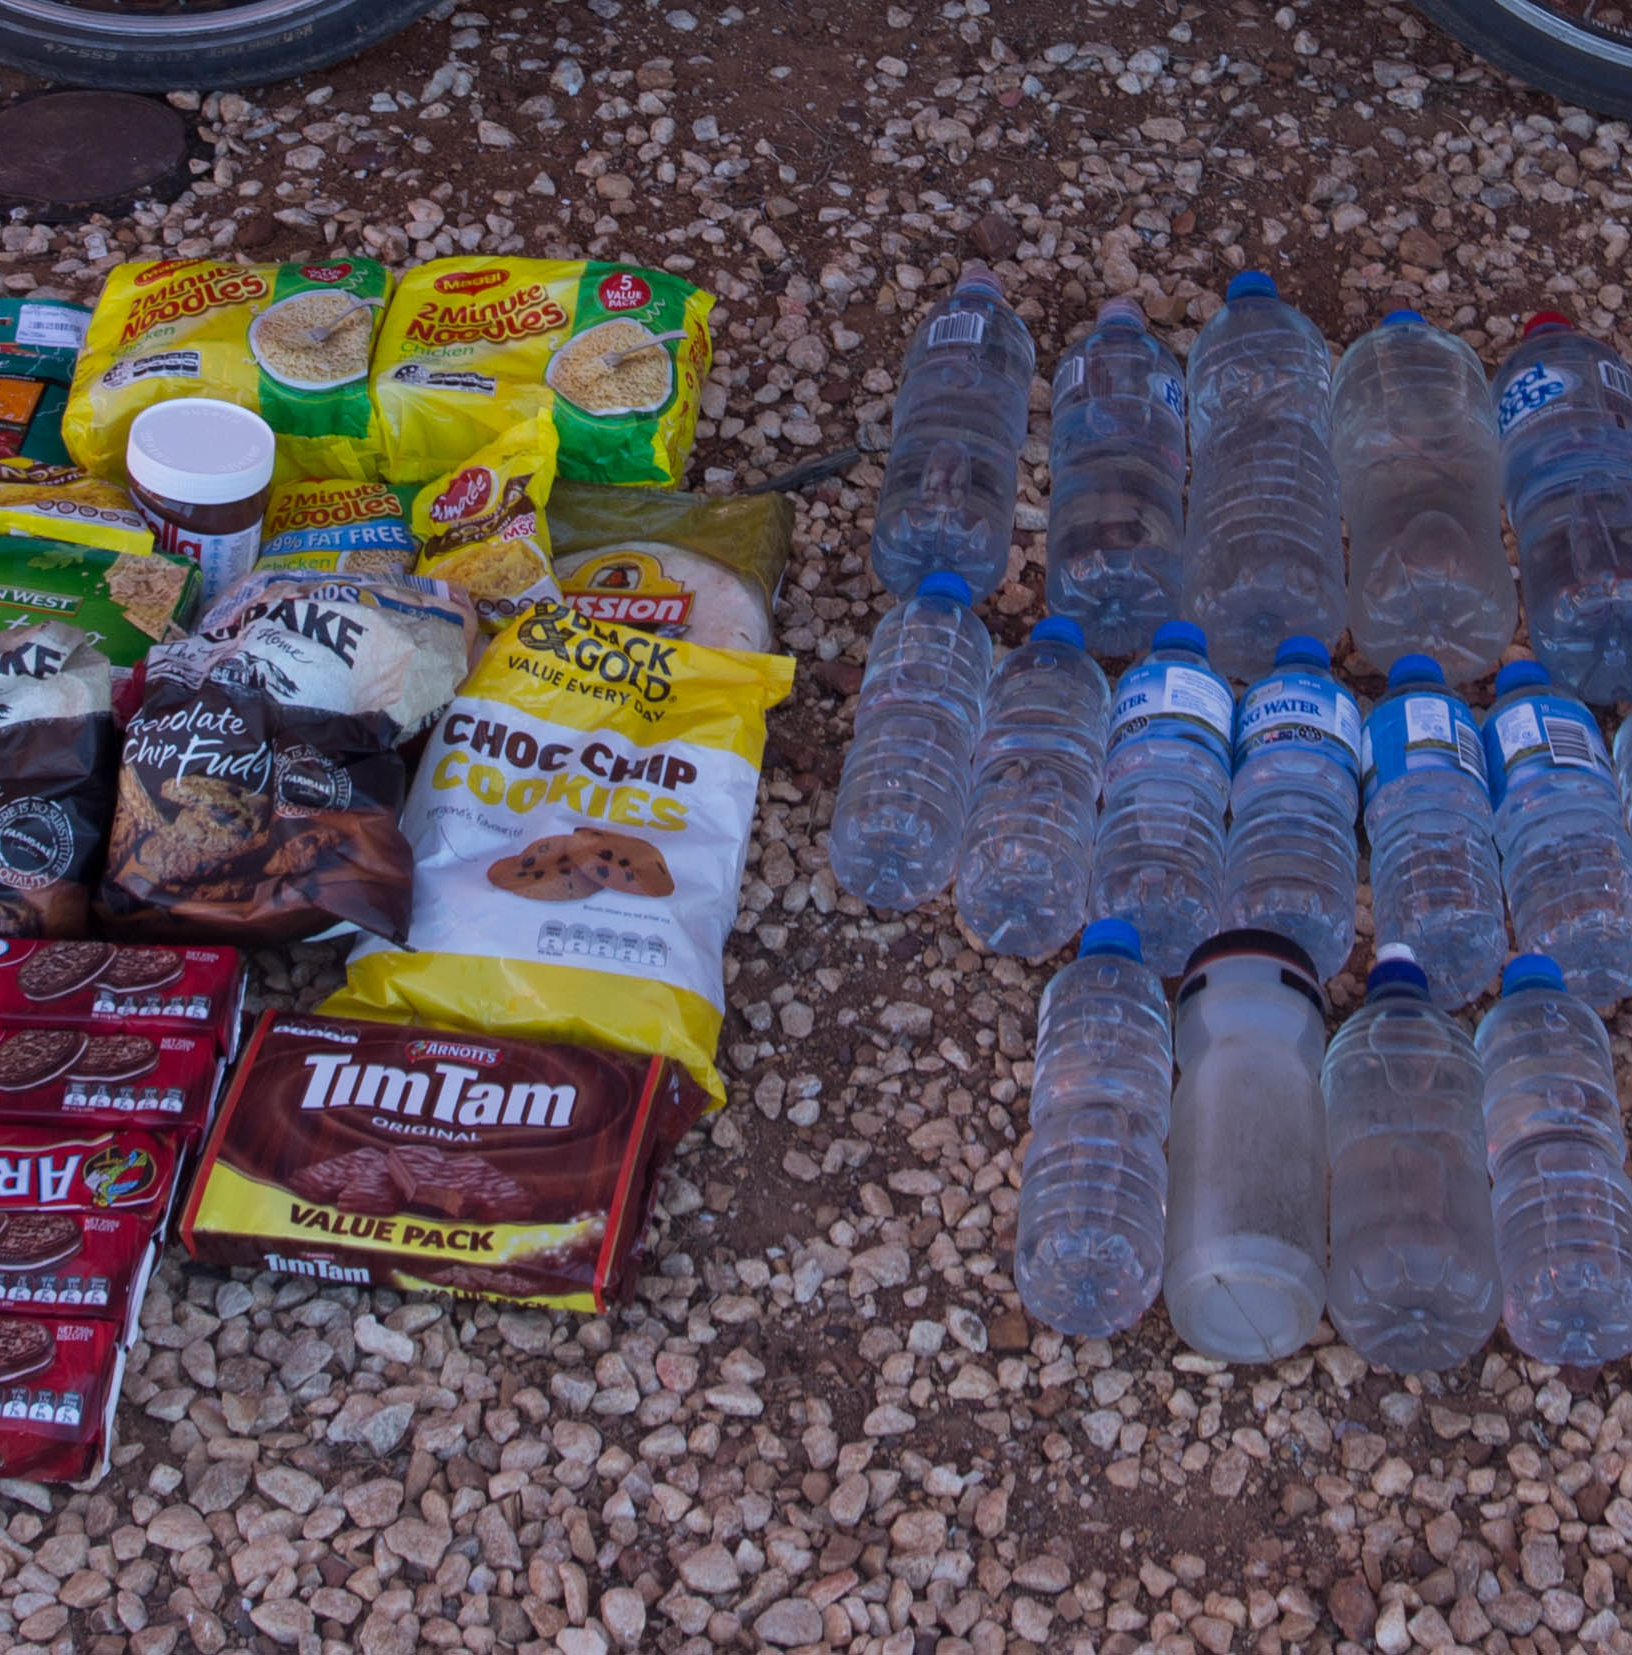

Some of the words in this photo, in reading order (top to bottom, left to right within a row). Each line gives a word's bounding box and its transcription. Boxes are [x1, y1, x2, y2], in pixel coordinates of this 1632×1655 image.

[619, 274, 633, 292] 5
[417, 302, 439, 321] 2
[438, 283, 546, 324] Minute
[606, 290, 643, 301] VALUE
[608, 298, 637, 308] PACK
[127, 298, 141, 319] 2
[277, 495, 292, 513] 2
[307, 528, 344, 547] FAT
[348, 525, 409, 545] FREE
[11, 589, 74, 611] WEST
[517, 600, 577, 663] &
[574, 638, 672, 703] GOLD
[571, 612, 677, 677] BLACK
[508, 655, 564, 687] VALUE
[566, 677, 632, 706] EVERY
[633, 699, 666, 724] DAY
[1263, 698, 1322, 718] WATER
[442, 712, 574, 772] CHOC
[580, 742, 698, 791] CHIP
[431, 749, 689, 832] COOKIES
[18, 802, 30, 814] IS
[30, 801, 49, 814] NO
[371, 1115, 483, 1143] ORIGINAL
[289, 1203, 397, 1243] VALUE
[401, 1225, 495, 1252] PACK
